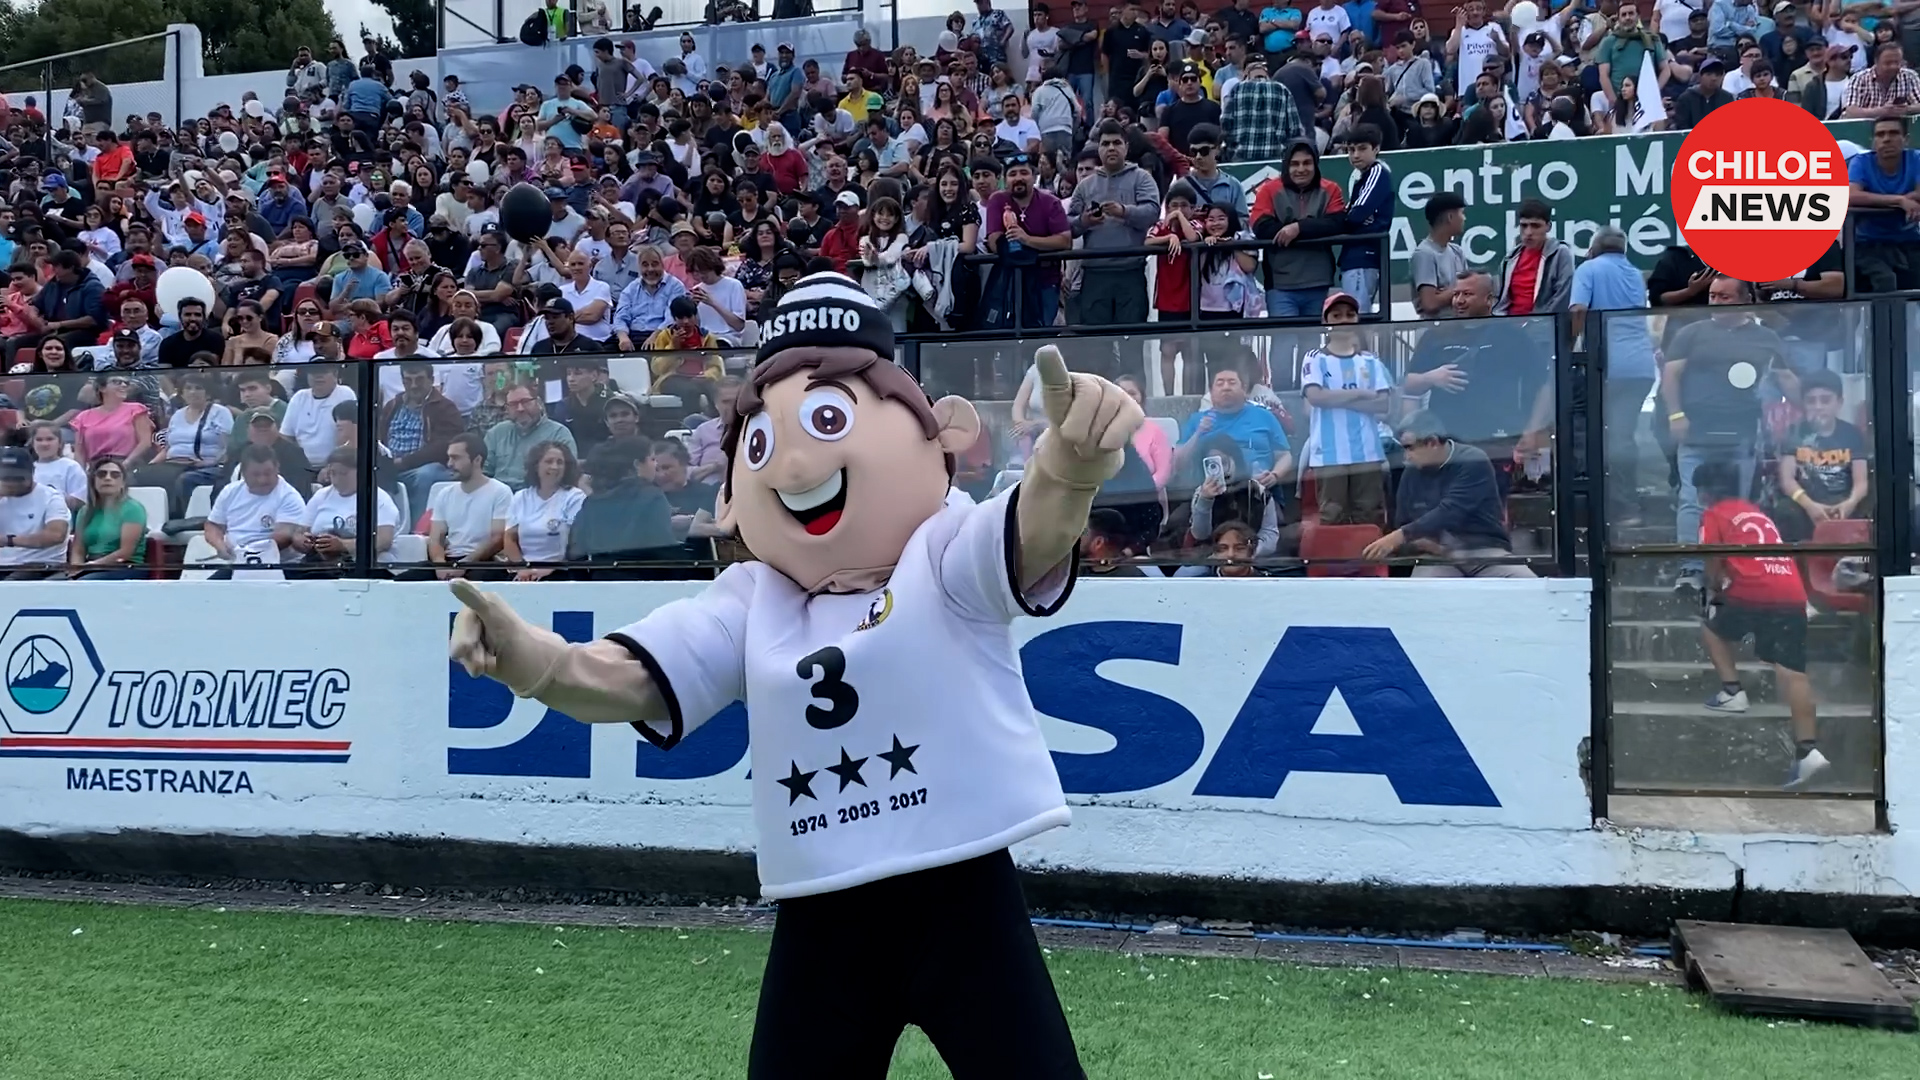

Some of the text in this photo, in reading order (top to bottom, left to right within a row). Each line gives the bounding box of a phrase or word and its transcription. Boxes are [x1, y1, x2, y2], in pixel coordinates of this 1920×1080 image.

[1615, 140, 1678, 197] M
[108, 669, 350, 729] TORMEC
[797, 646, 860, 729] 3
[66, 767, 254, 794] MAESTRANZA
[790, 787, 928, 837] 1974 2003 2017
